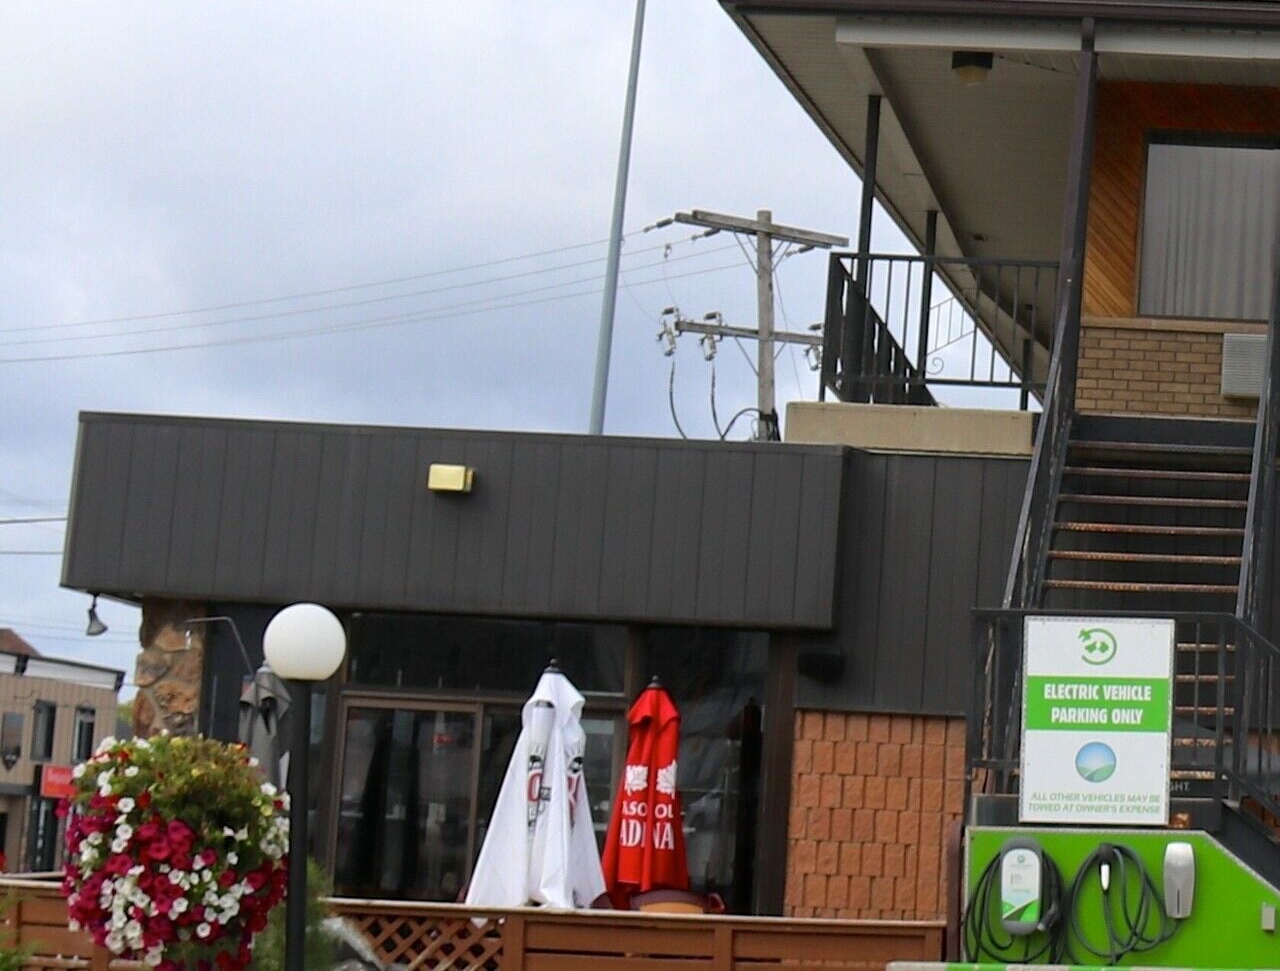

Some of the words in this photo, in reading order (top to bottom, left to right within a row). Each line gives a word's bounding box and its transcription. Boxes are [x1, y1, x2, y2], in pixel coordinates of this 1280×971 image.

[1043, 683, 1099, 700] ELECTRIC
[1102, 685, 1152, 701] VEHICLE
[1051, 707, 1107, 724] PARKING
[1111, 708, 1143, 724] ONLY
[1030, 792, 1048, 801] ALL
[1049, 793, 1080, 802] OTHER
[1080, 793, 1126, 803] VEHICLES
[1127, 794, 1147, 803] MAY
[1028, 803, 1060, 812] TOWED
[1062, 804, 1075, 812] AT
[1119, 805, 1160, 814] EXPENSE
